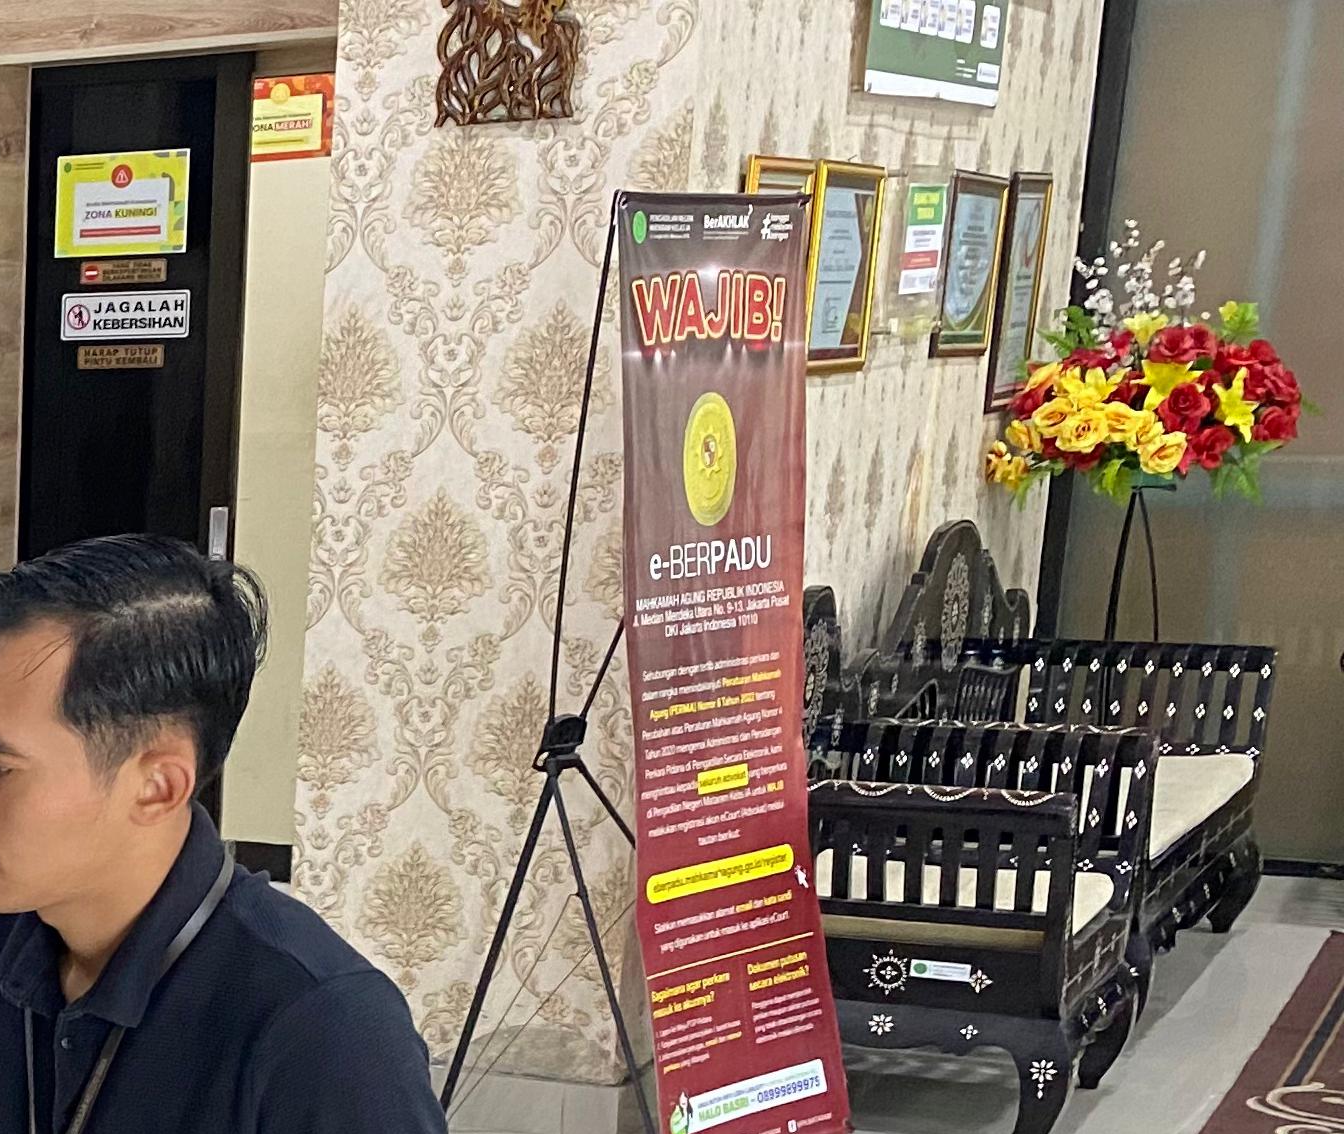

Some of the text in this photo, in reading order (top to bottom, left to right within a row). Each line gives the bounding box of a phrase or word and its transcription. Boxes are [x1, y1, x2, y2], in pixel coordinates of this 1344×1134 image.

[115, 208, 157, 218] KUNING!
[94, 299, 184, 314] JAGALAH
[632, 270, 786, 346] WAJIB!
[93, 317, 184, 330] KEBERSIHAN
[650, 535, 771, 580] e-BERPADU
[707, 585, 745, 602] REPUBLIK
[745, 580, 785, 597] INDONESIA
